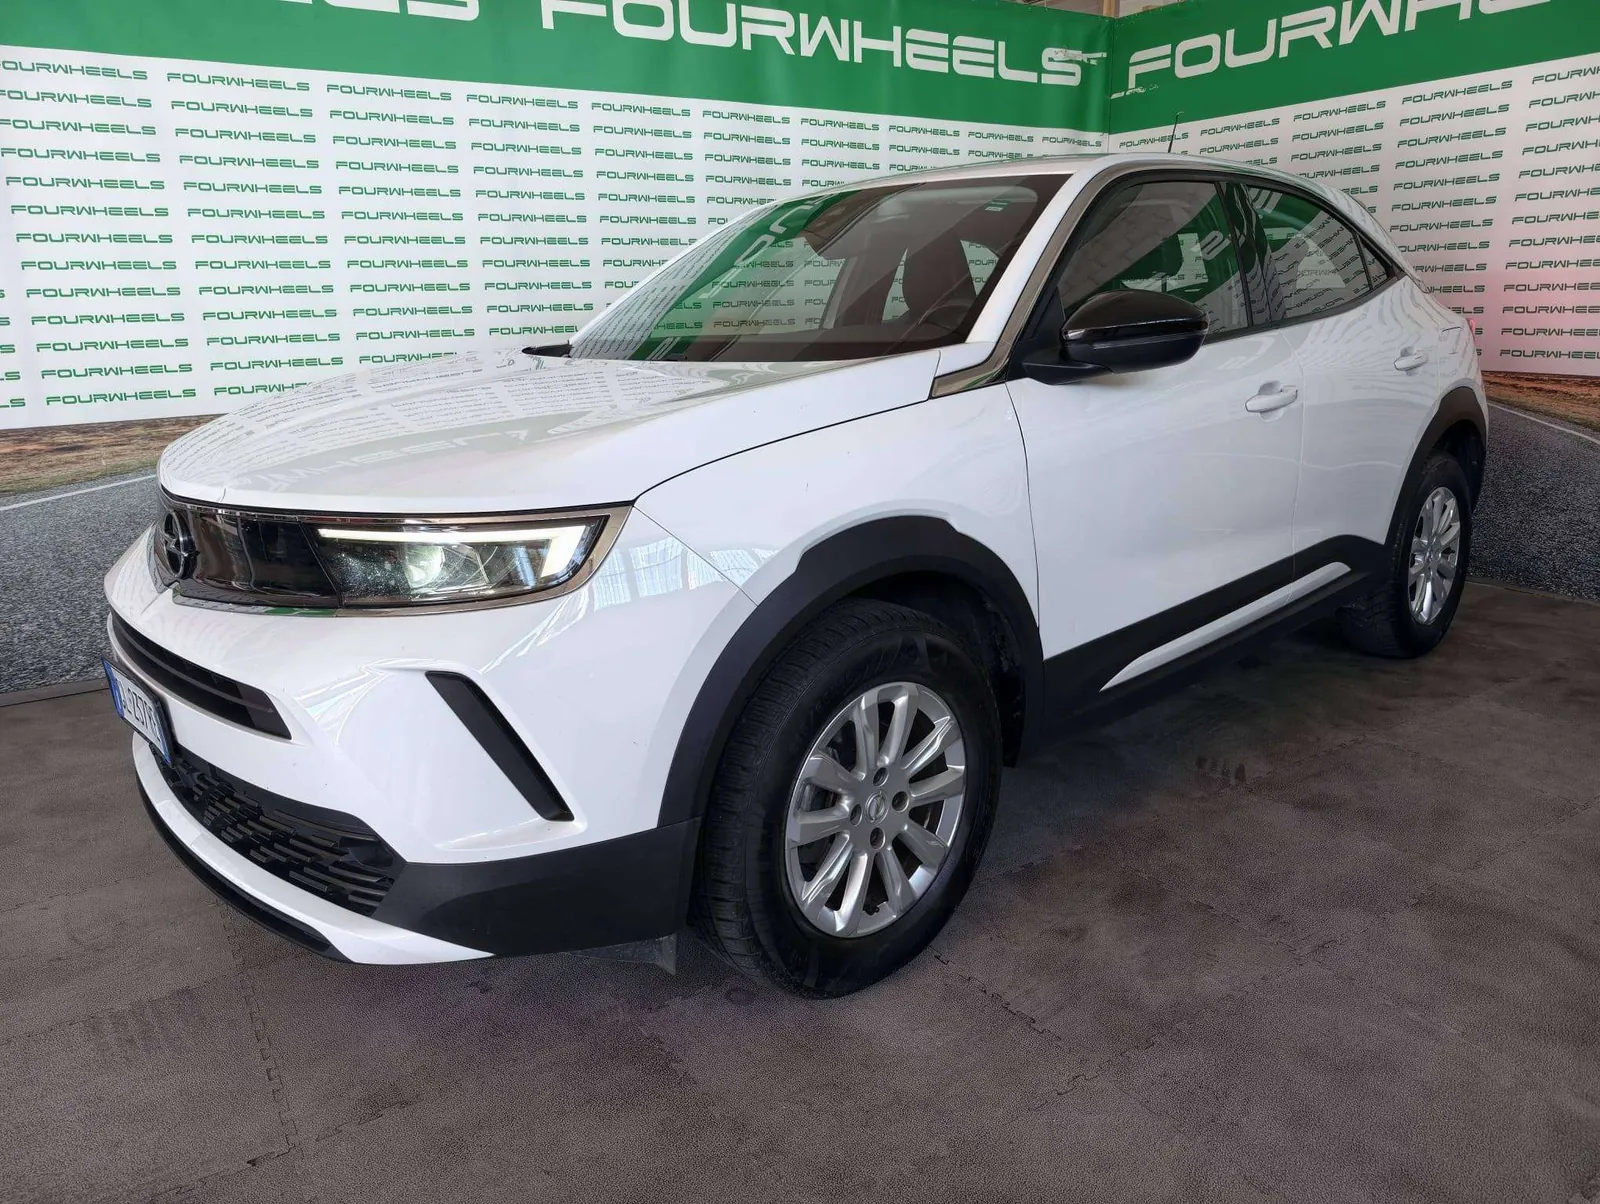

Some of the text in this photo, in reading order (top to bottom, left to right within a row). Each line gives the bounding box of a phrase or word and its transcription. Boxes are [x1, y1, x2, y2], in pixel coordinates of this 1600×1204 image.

[540, 0, 1081, 86] FOURWHEELS
[1128, 0, 1551, 92] FOURWH
[0, 61, 1101, 147] OURWHEELS FOURWHEELS FOURWHEELS FOURWHEELS FOURWHEELS FOURWHEELS FOURWHEELS FOURWHEELS FOURWHEELS FOURWHEELS
[1119, 66, 1600, 148] FOURWHEELS FOURWHEELS FOURWHEELS FOURWHEELS FOURW
[171, 101, 313, 117] FOURWHEELS
[330, 110, 454, 125] FOURWHEELS
[469, 118, 580, 132] FOURWHEELS
[593, 126, 692, 138] FOURWHEELS
[704, 132, 790, 145] FOURWHEELS
[801, 139, 879, 151] FOURWHEELS
[889, 145, 960, 155] FOURWHEELS
[1200, 91, 1600, 154] FOURWHEELS FOURWHEELS FOURWHEELS FOURWH
[175, 128, 316, 143] FOURWHEELS
[333, 136, 456, 149] FOURWHEELS
[471, 143, 582, 155] FOURWHEELS
[595, 148, 693, 160] FOURWHEELS
[705, 154, 791, 165] FOURWHEELS
[802, 159, 880, 170] FOURWHEELS
[1291, 143, 1382, 162] FOURWHEELS
[1397, 127, 1506, 148] FOURWHEELS
[1526, 115, 1600, 132] FOURWH
[0, 148, 160, 162] FOURWHEELS
[179, 155, 319, 168] FOURWHEELS
[336, 161, 458, 173] FOURWHEELS
[473, 166, 583, 178] FOURWHEELS
[596, 171, 694, 182] FOURWHEELS
[706, 175, 791, 186] FOURWHEELS
[1296, 139, 1600, 179] URWHEELS FOURWHEELS FOURWH
[6, 177, 776, 205] FOURWHEELS FOURWHEELS FOURWHEELS FOURWHEELS FOURWHEELS FOURWHE
[1393, 173, 1500, 191] FOURWHEELS
[1391, 196, 1497, 212] FOURWHEELS
[1515, 187, 1600, 202] FOURWHE
[11, 205, 696, 224] FOURWHEELS FOURWHEELS FOURWHEELS FOURWHEELS FOURWHEELS
[1390, 211, 1600, 232] FOURWHEELS FOURWHE
[16, 233, 173, 243] FOURWHEELS
[191, 235, 328, 244] FOURWHEELS
[344, 236, 465, 244] FOURWHEELS
[480, 237, 588, 245] FOURWHEELS
[1397, 235, 1600, 253] OURWHEELS FOURWHE
[21, 259, 668, 270] FOURWHEELS FOURWHEELS FOURWHEELS FOURWHEELS FOURWH
[744, 260, 794, 268] WHEELS
[1413, 259, 1600, 273] RWHEELS FOURWHEE
[26, 282, 592, 298] FOURWHEELS FOURWHEELS FOURWHEELS FOURWHEELS
[1504, 282, 1600, 292] FOURWHEE
[31, 303, 593, 325] FOURWHEELS FOURWHEELS FOURWHEELS FOURWHEELS
[713, 299, 795, 308] FOURWHEELS
[1503, 306, 1600, 314] FOURWHEE
[714, 318, 796, 328] FOURWHEELS
[1501, 328, 1600, 336] FOURWHEE
[36, 325, 579, 352] FOURWHEELS FOURWHEELS FOURWHEELS FOURWHEE
[41, 364, 192, 379] FOURWHEELS
[210, 357, 343, 371] FOURWHEELS
[46, 382, 307, 406] FOURWHEELS FOURWH
